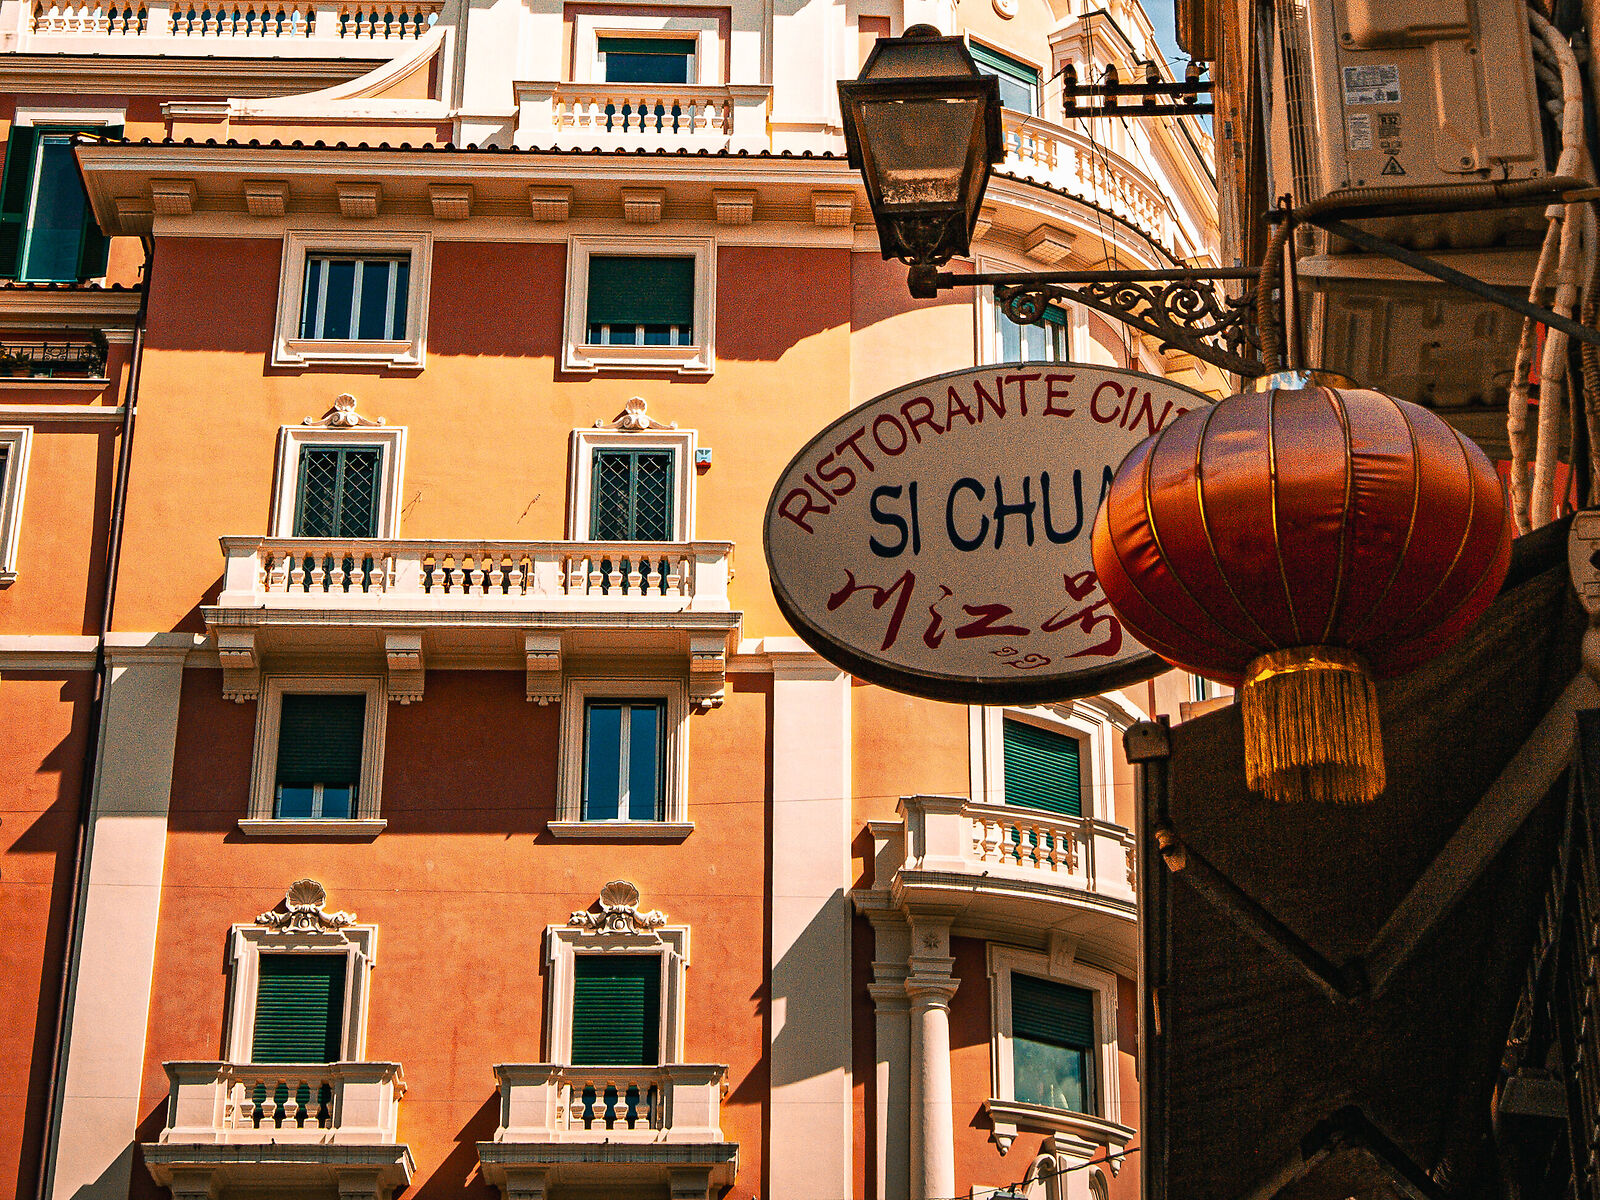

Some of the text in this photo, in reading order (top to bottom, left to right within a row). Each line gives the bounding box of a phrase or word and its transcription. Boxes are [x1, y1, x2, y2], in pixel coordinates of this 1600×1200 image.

[778, 373, 1190, 534] RISTORANTE CIN
[869, 481, 921, 558] SI
